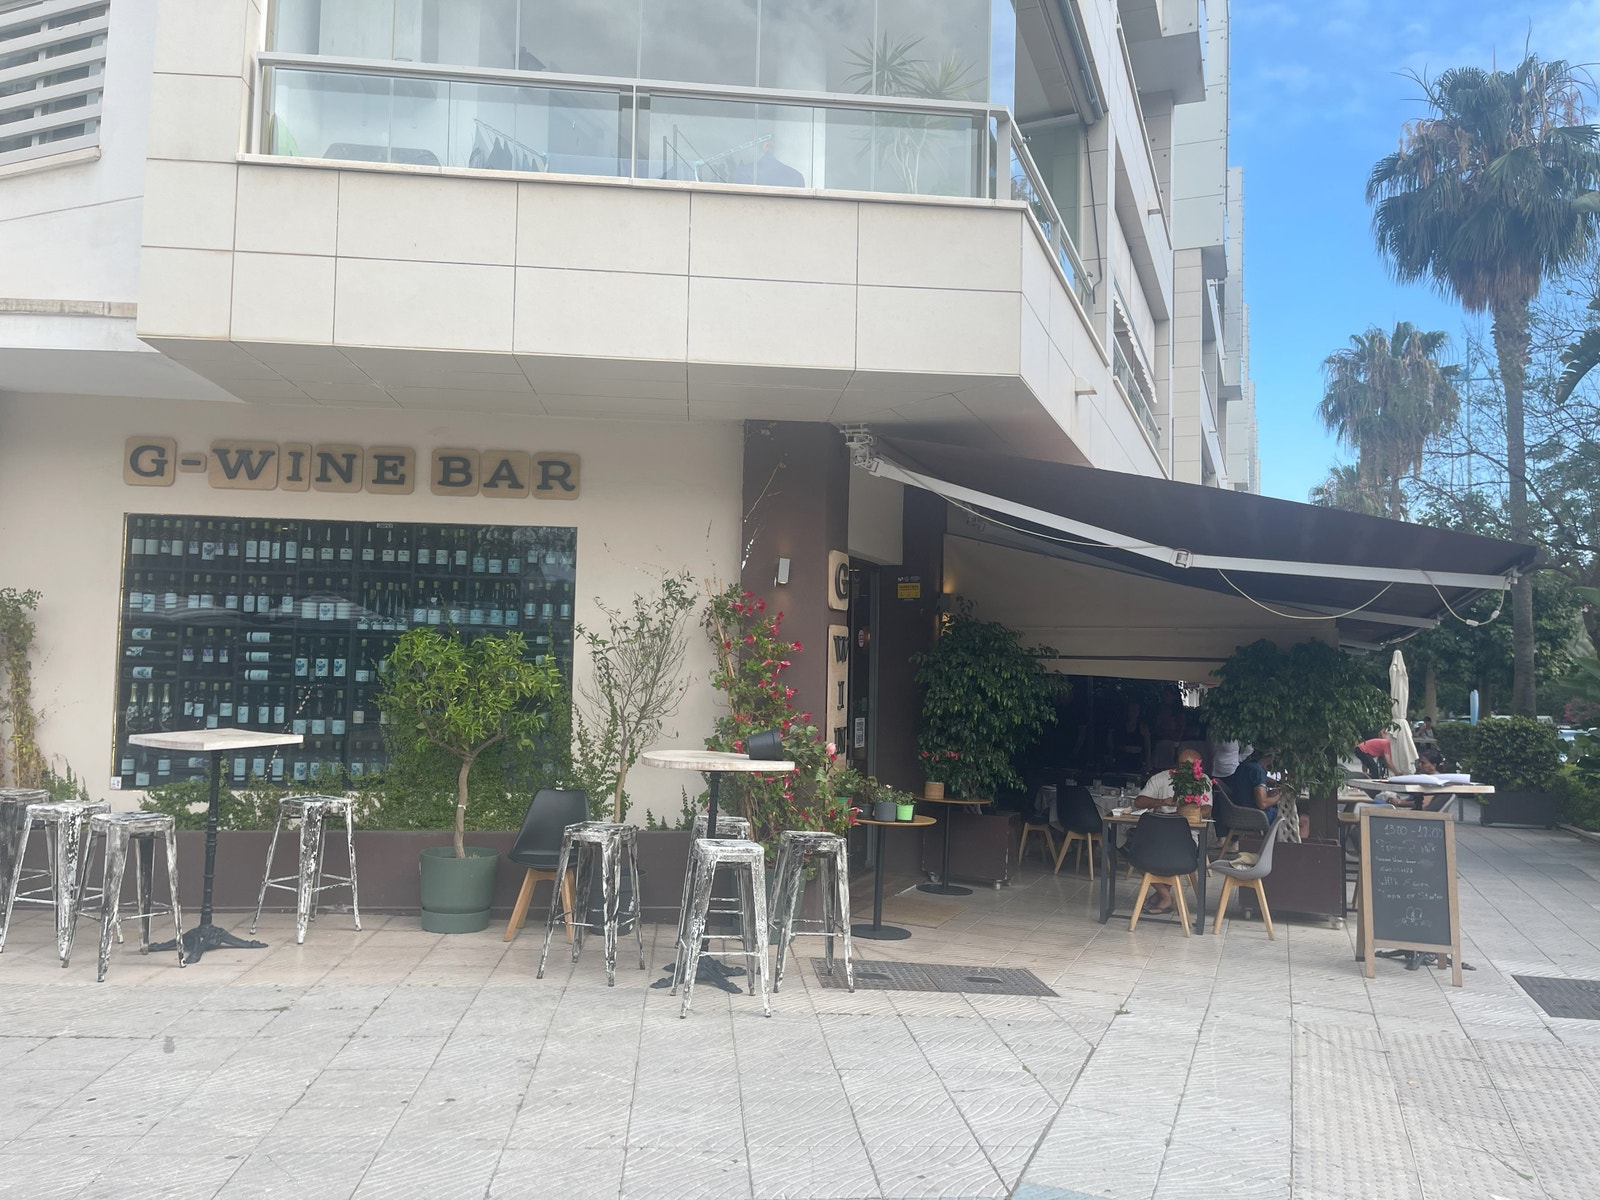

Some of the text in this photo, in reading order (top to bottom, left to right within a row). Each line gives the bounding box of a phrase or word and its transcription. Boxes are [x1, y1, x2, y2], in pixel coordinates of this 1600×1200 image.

[129, 444, 576, 492] G-WINE BAR
[834, 562, 849, 600] G
